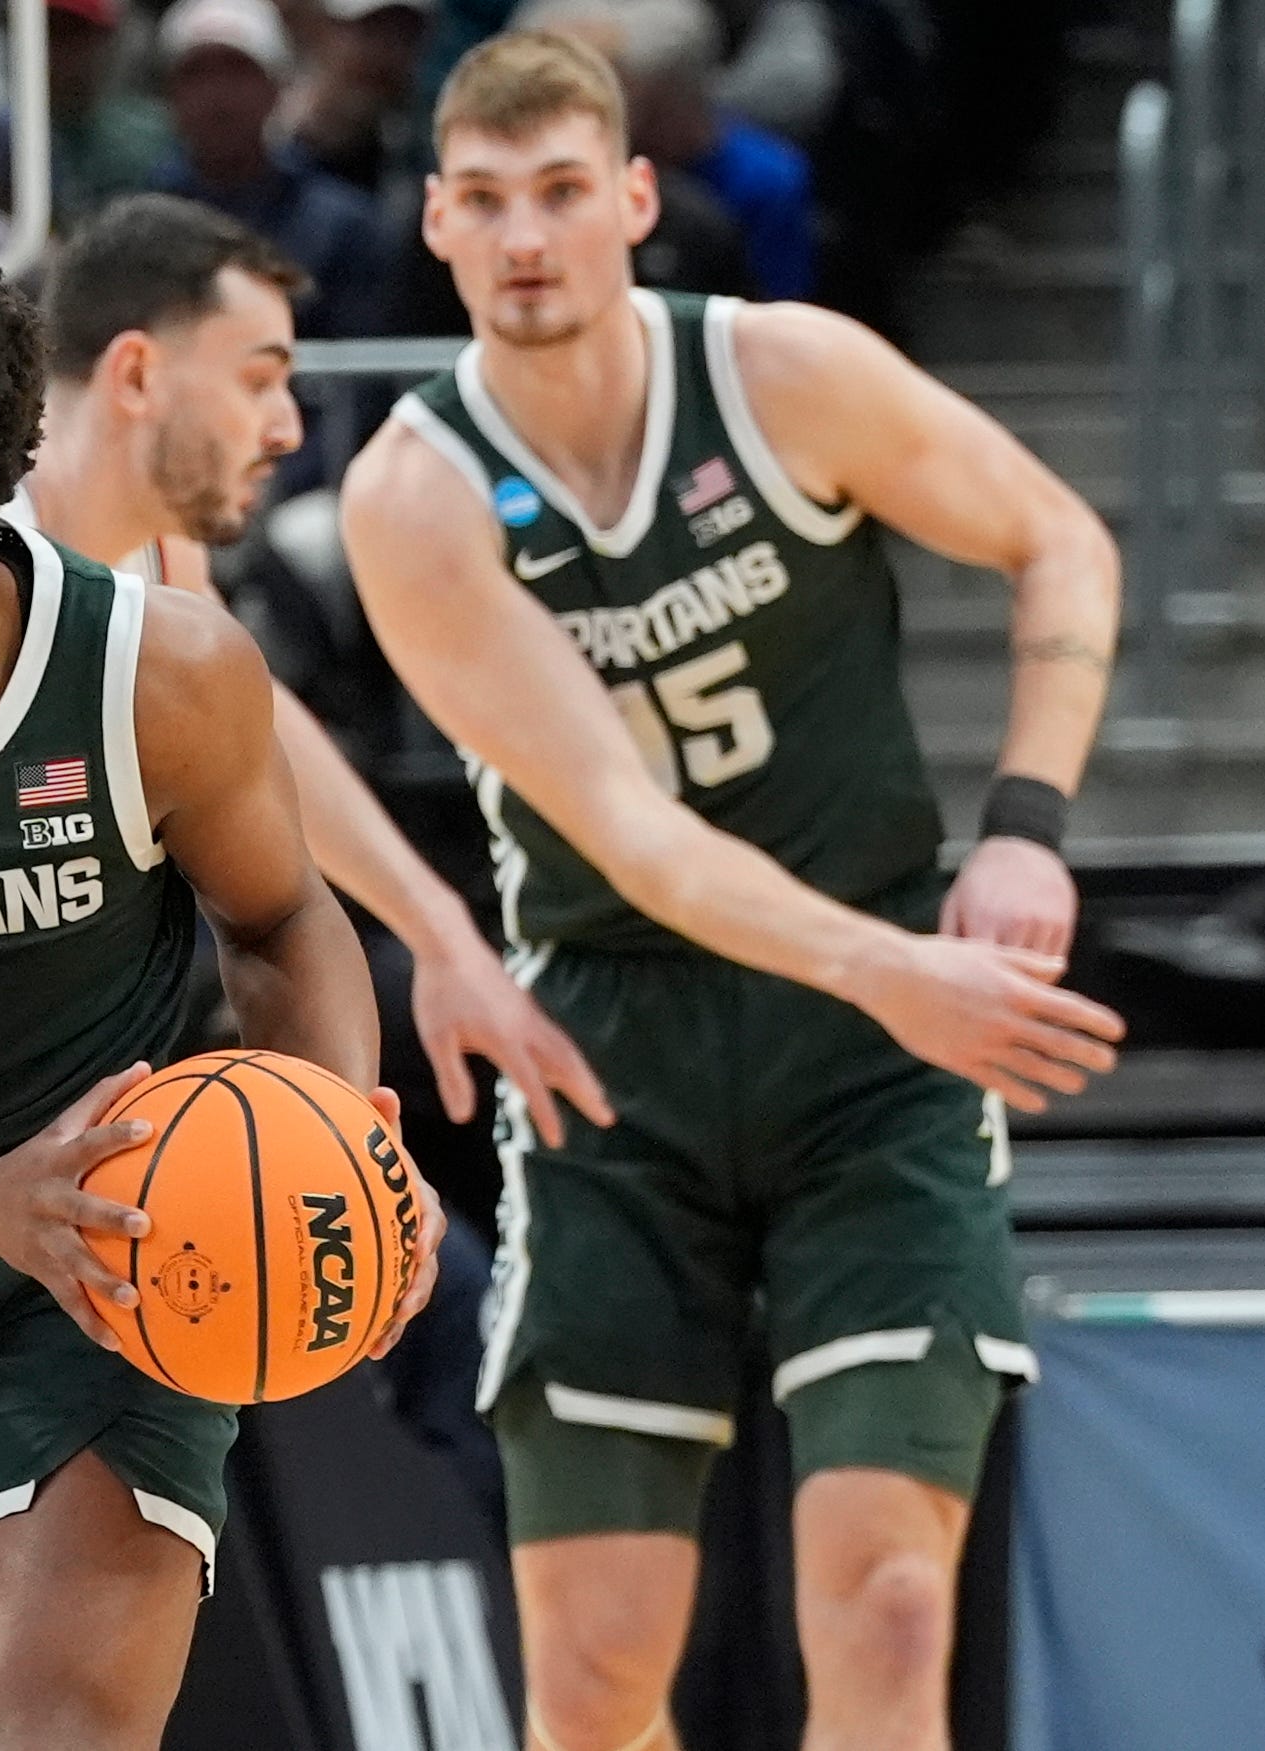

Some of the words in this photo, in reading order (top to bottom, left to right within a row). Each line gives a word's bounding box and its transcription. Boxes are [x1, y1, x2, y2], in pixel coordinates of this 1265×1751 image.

[554, 540, 790, 668] PARTANS
[19, 812, 95, 850] BIG
[287, 1194, 306, 1268] OFFICIAL
[300, 1192, 355, 1353] NCAA
